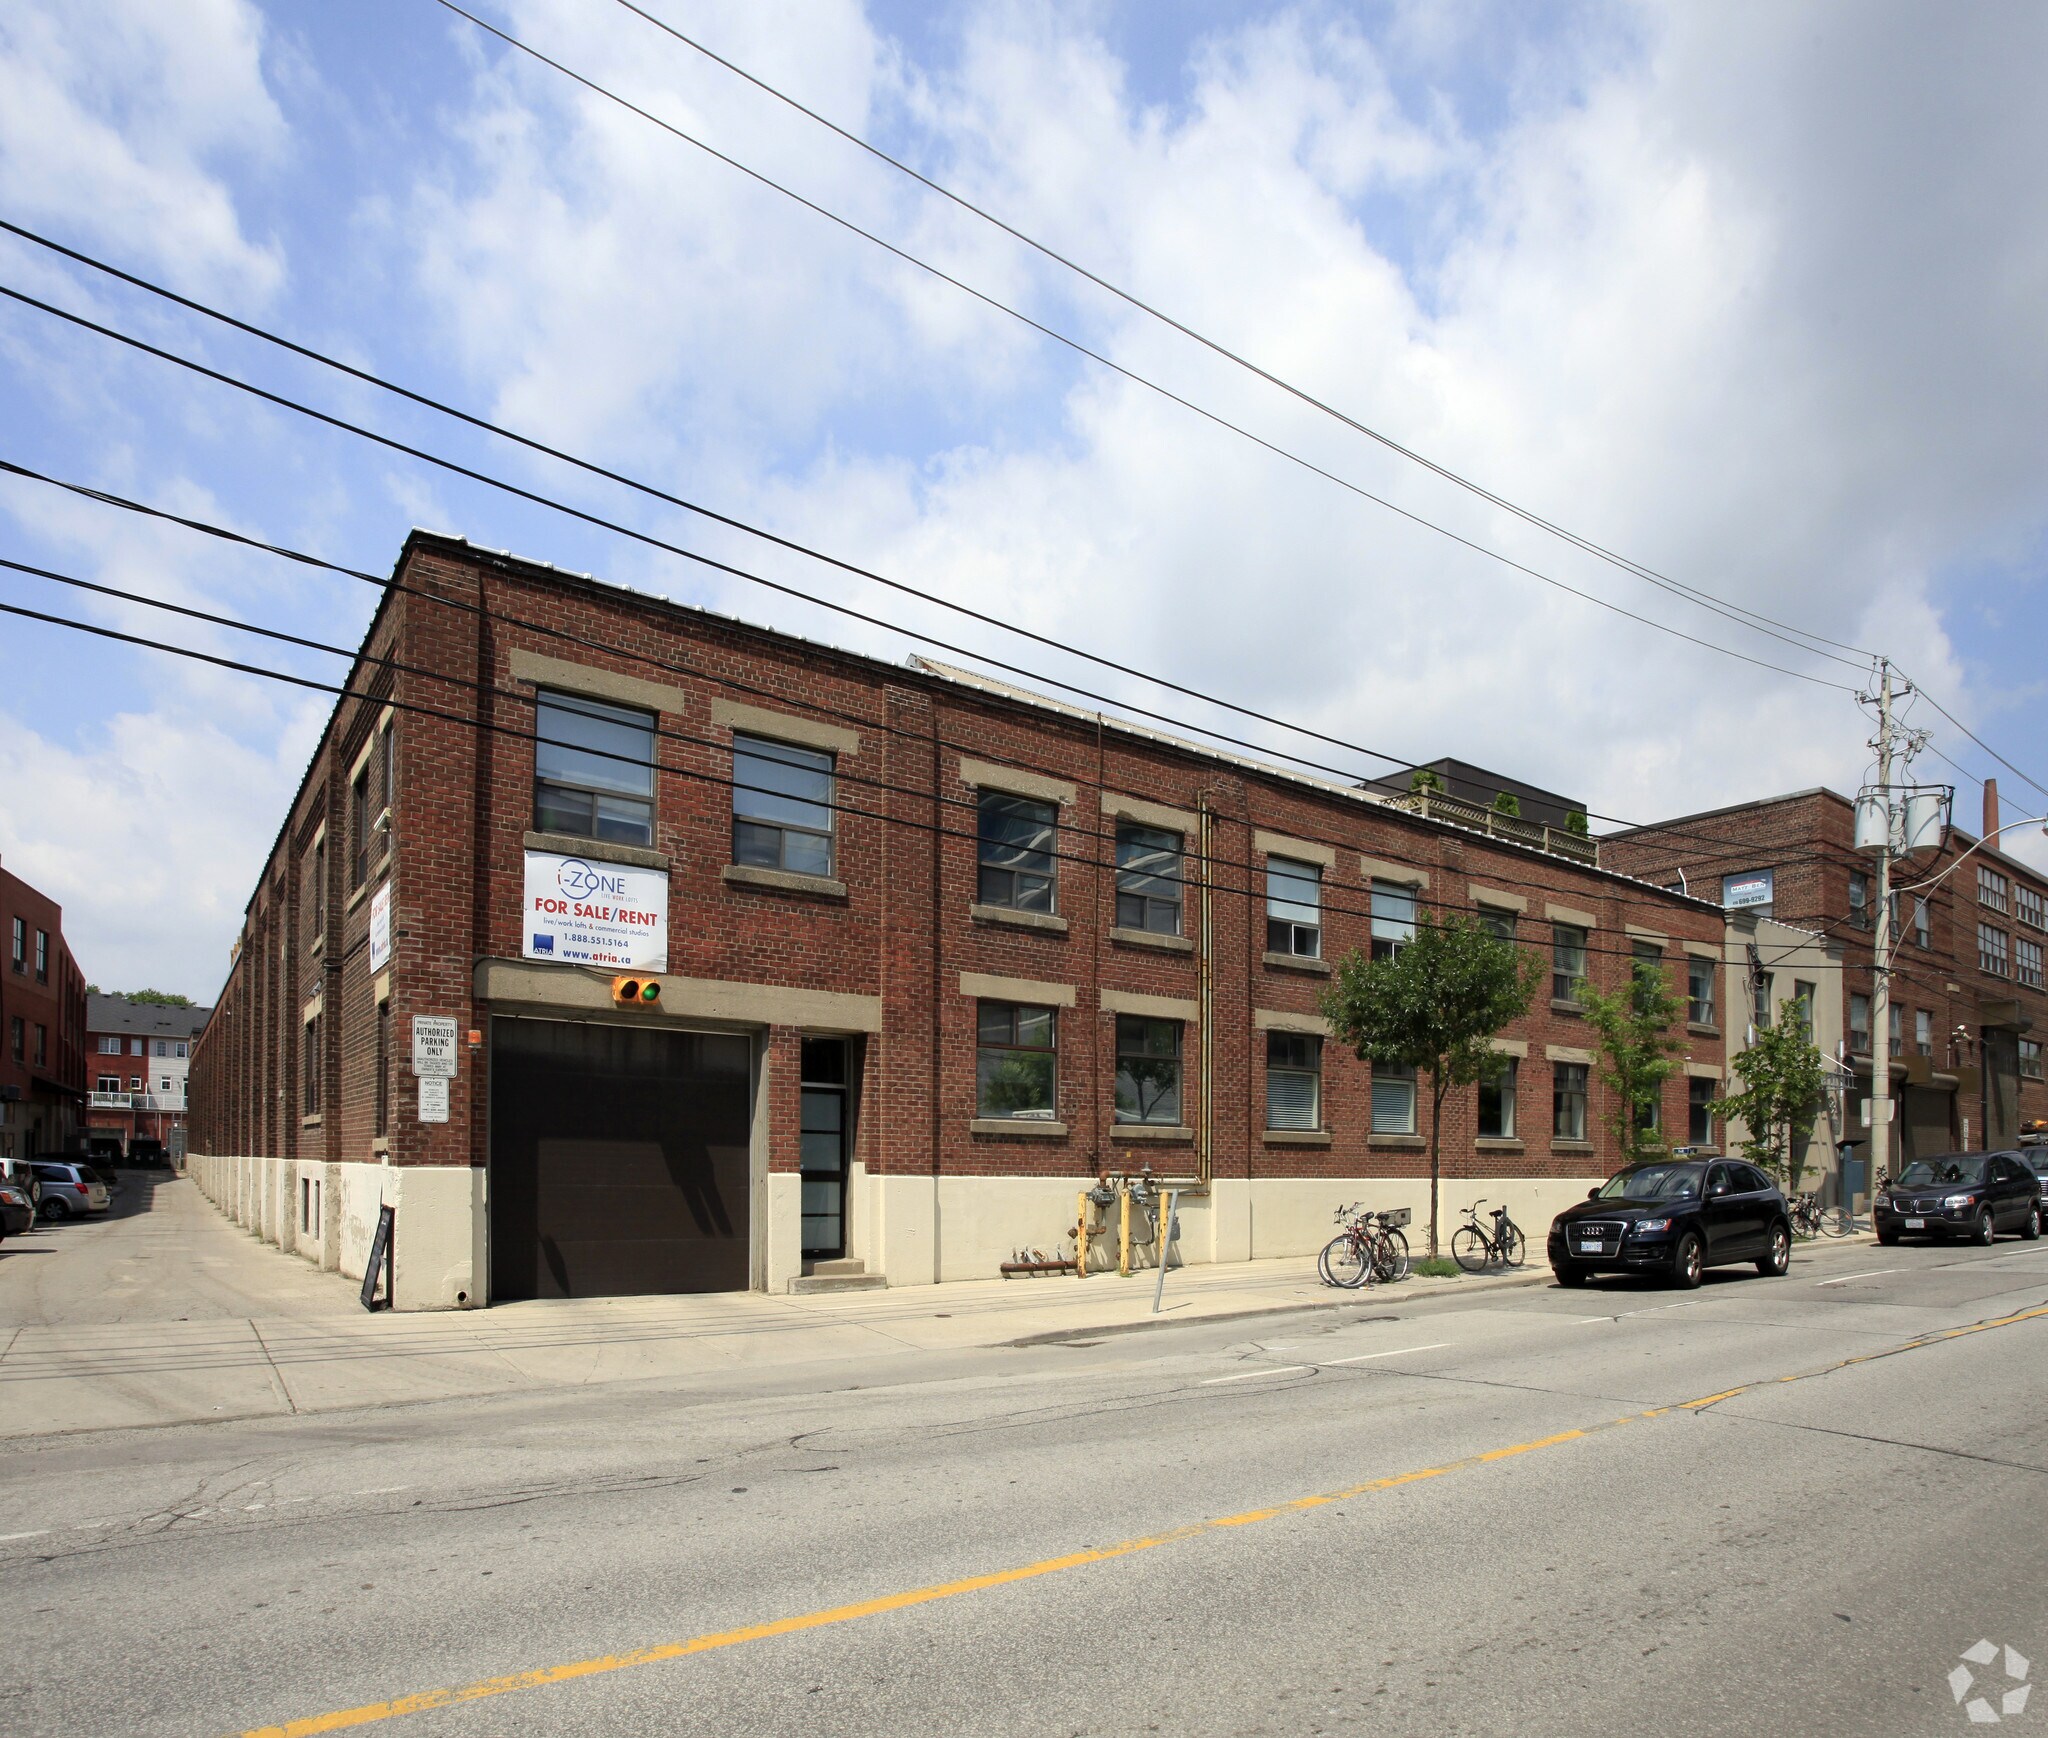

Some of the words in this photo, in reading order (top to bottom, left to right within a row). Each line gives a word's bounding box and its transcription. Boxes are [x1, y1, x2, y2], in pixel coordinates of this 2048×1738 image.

[535, 897, 567, 914] FOR
[574, 902, 657, 926] SALE/RENT
[543, 917, 573, 928] live/work
[574, 920, 587, 930] lofts
[595, 925, 628, 935] commercial
[629, 929, 650, 937] studios
[564, 933, 629, 948] 1.888.551.5164
[533, 947, 553, 956] ATRIA
[563, 950, 631, 964] www.atria.ca
[416, 1027, 454, 1037] AUTHORIZED
[421, 1037, 449, 1047] PARKING
[427, 1047, 443, 1056] ONLY
